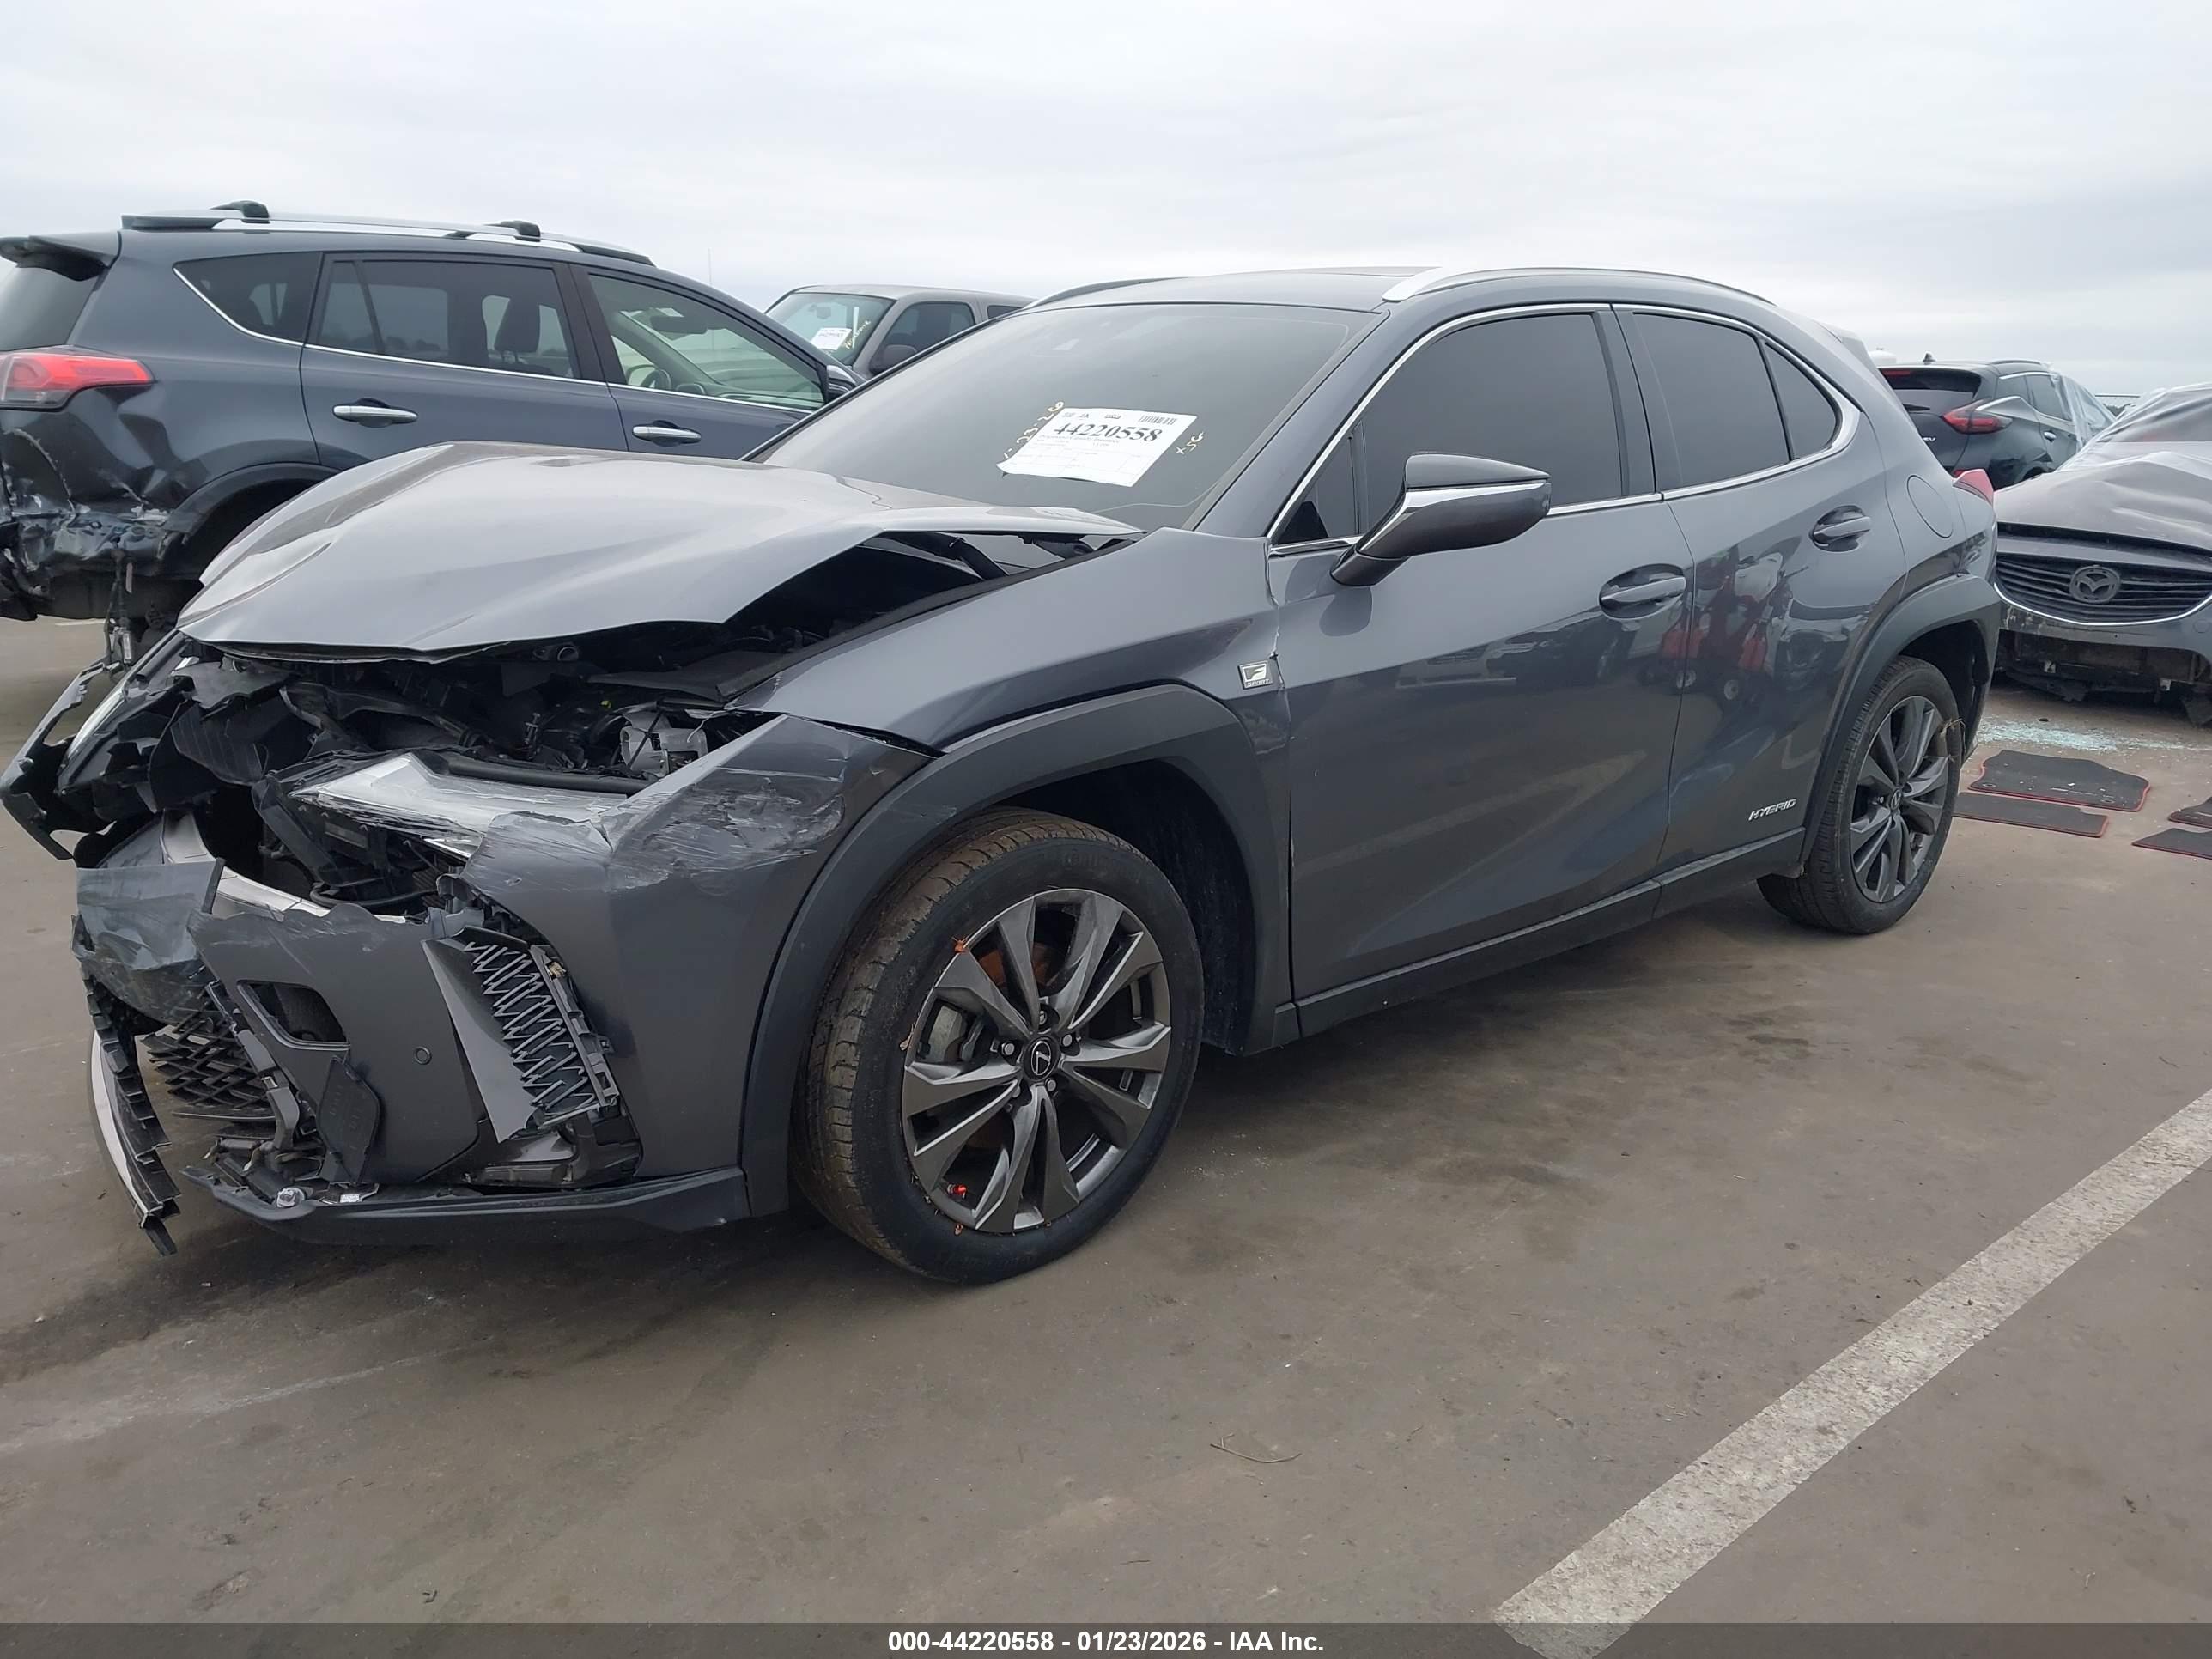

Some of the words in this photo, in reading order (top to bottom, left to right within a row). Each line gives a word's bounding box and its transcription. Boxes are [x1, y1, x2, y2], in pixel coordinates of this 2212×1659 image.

[1054, 422, 1163, 441] 44220558
[1247, 678, 1270, 687] SPORT
[1748, 798, 1797, 821] HYBRID
